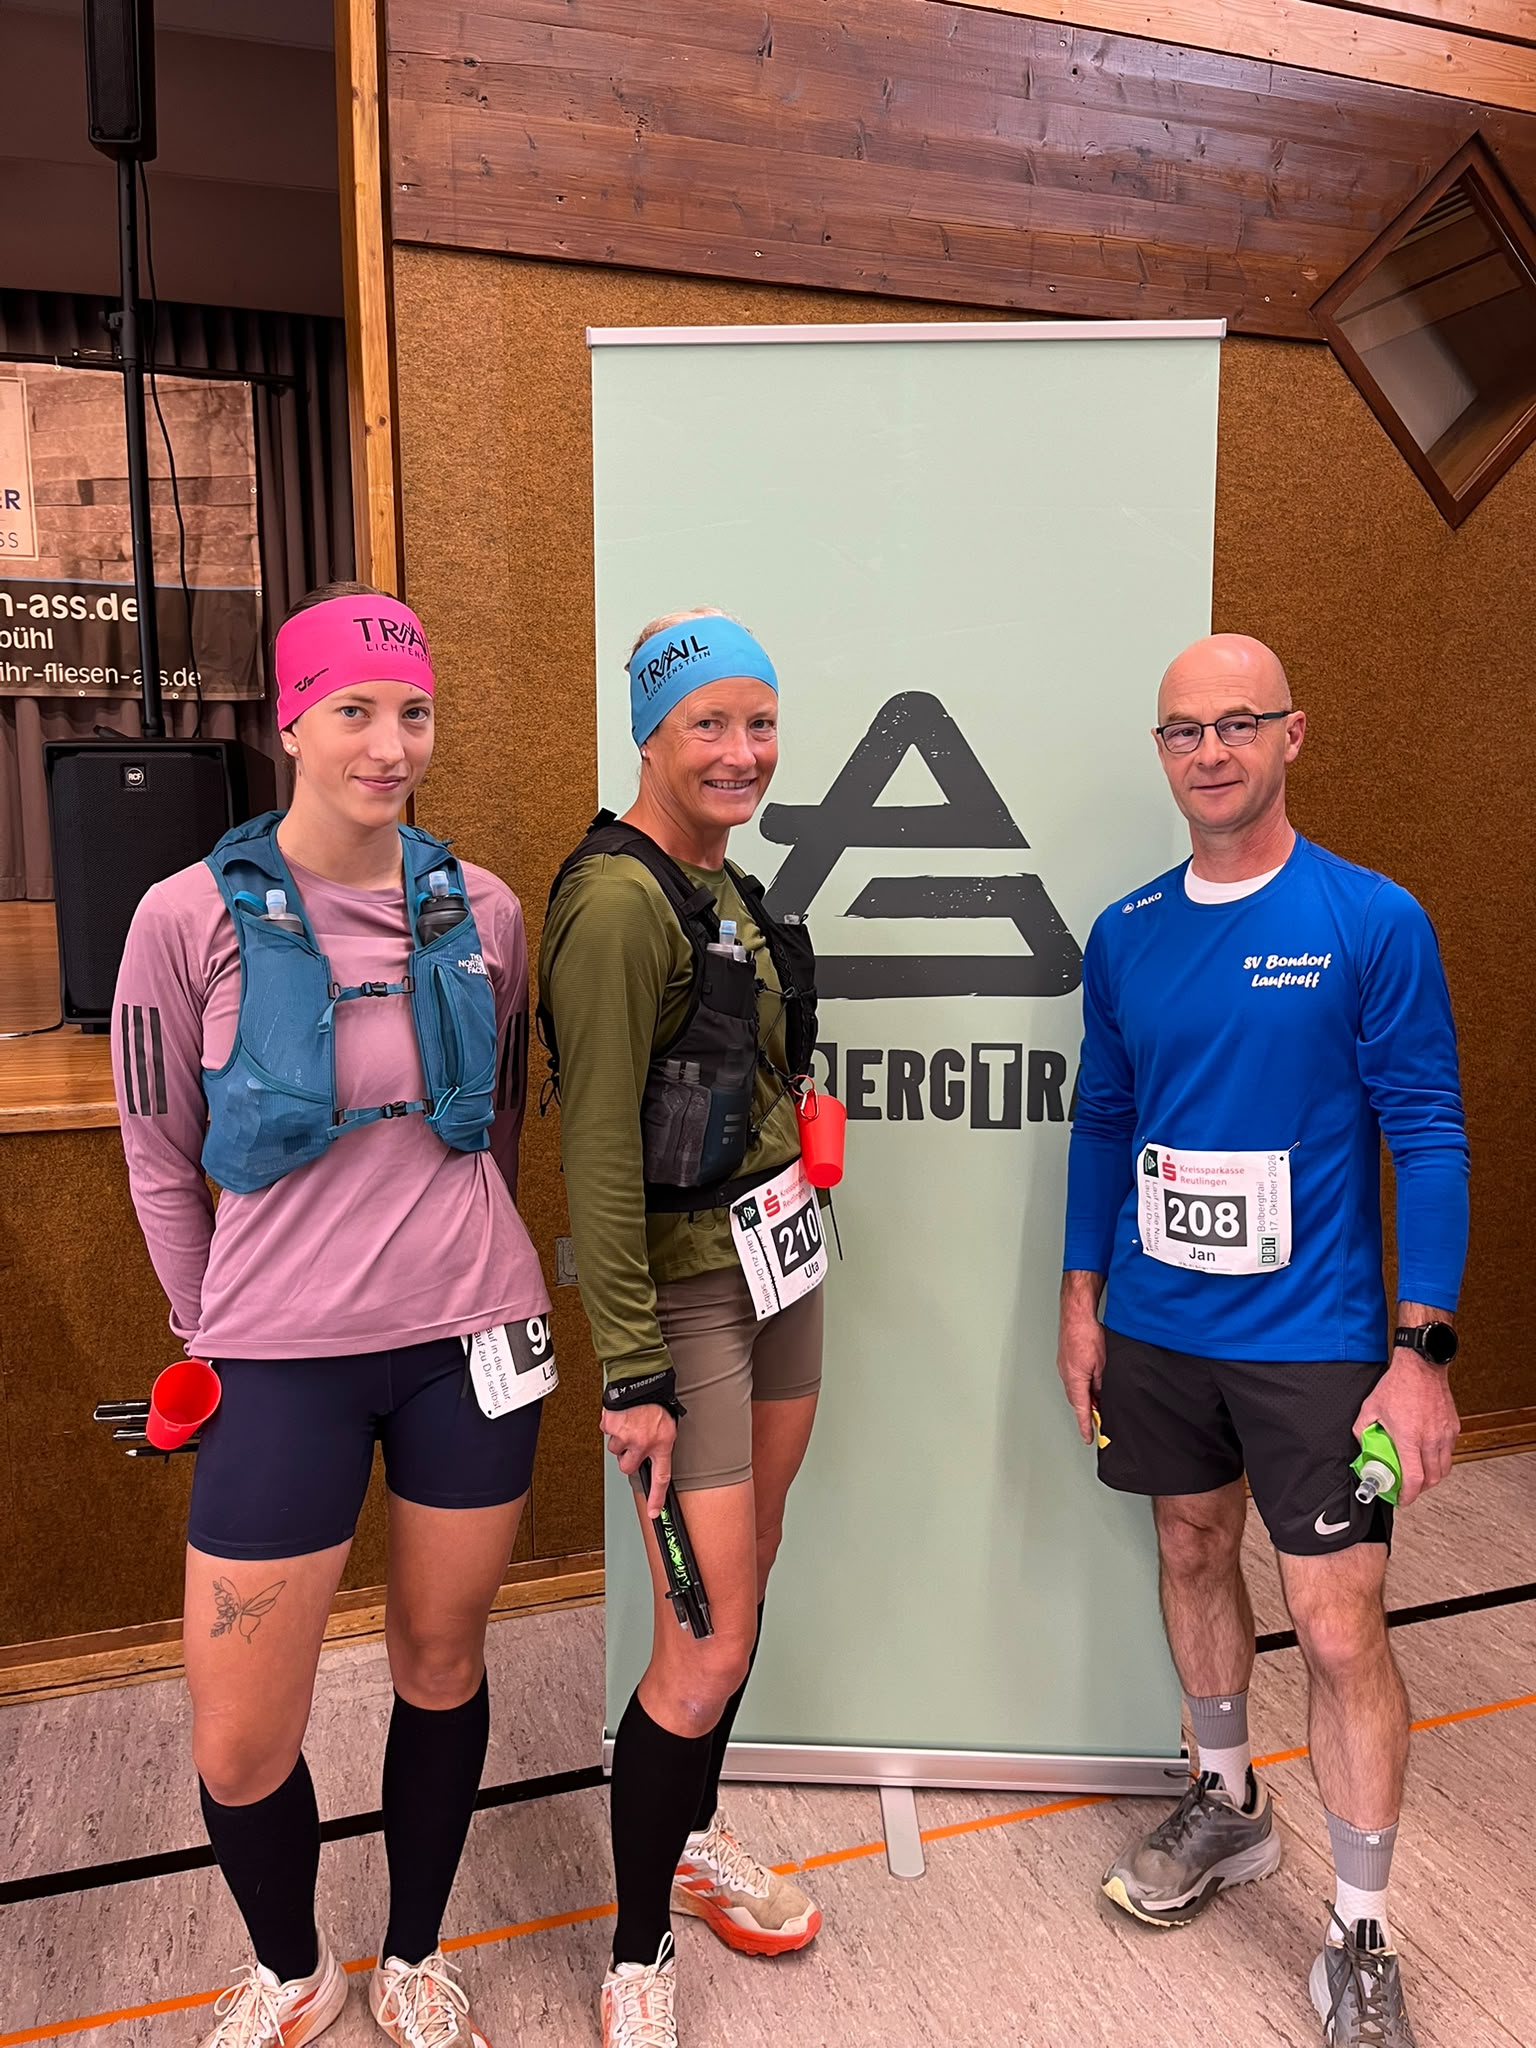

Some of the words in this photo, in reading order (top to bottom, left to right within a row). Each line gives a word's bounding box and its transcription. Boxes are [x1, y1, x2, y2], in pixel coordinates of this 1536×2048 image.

[0, 489, 21, 510] R
[638, 635, 708, 693] TRAIL
[647, 651, 711, 701] LICHTENSTEIN
[1136, 892, 1162, 909] JAKO
[1243, 956, 1262, 969] SV
[1265, 953, 1332, 969] Bondorf
[1251, 971, 1320, 988] Lauftreff
[812, 1043, 1081, 1129] ERGTR
[1179, 1165, 1245, 1175] Kreissparkasse
[1268, 1154, 1277, 1177] 2026
[1152, 1181, 1160, 1200] Lauf
[1180, 1176, 1227, 1187] Reutlingen
[1256, 1182, 1267, 1232] Bolbergtrail
[1269, 1180, 1278, 1215] Oktober
[1168, 1197, 1240, 1239] 208
[779, 1208, 818, 1266] 210
[1189, 1247, 1215, 1261] Jan
[1262, 1238, 1275, 1263] BBT
[746, 1234, 757, 1254] Lauf
[752, 1256, 760, 1267] zu
[756, 1268, 764, 1281] Dir
[761, 1283, 773, 1310] selbst
[804, 1261, 819, 1278] Uta
[474, 1331, 485, 1347] auf
[486, 1327, 497, 1342] auf
[526, 1316, 551, 1356] 9
[479, 1350, 486, 1361] zu
[491, 1345, 498, 1354] in
[483, 1363, 492, 1377] Dir
[494, 1356, 502, 1371] die
[488, 1380, 501, 1410] selbst
